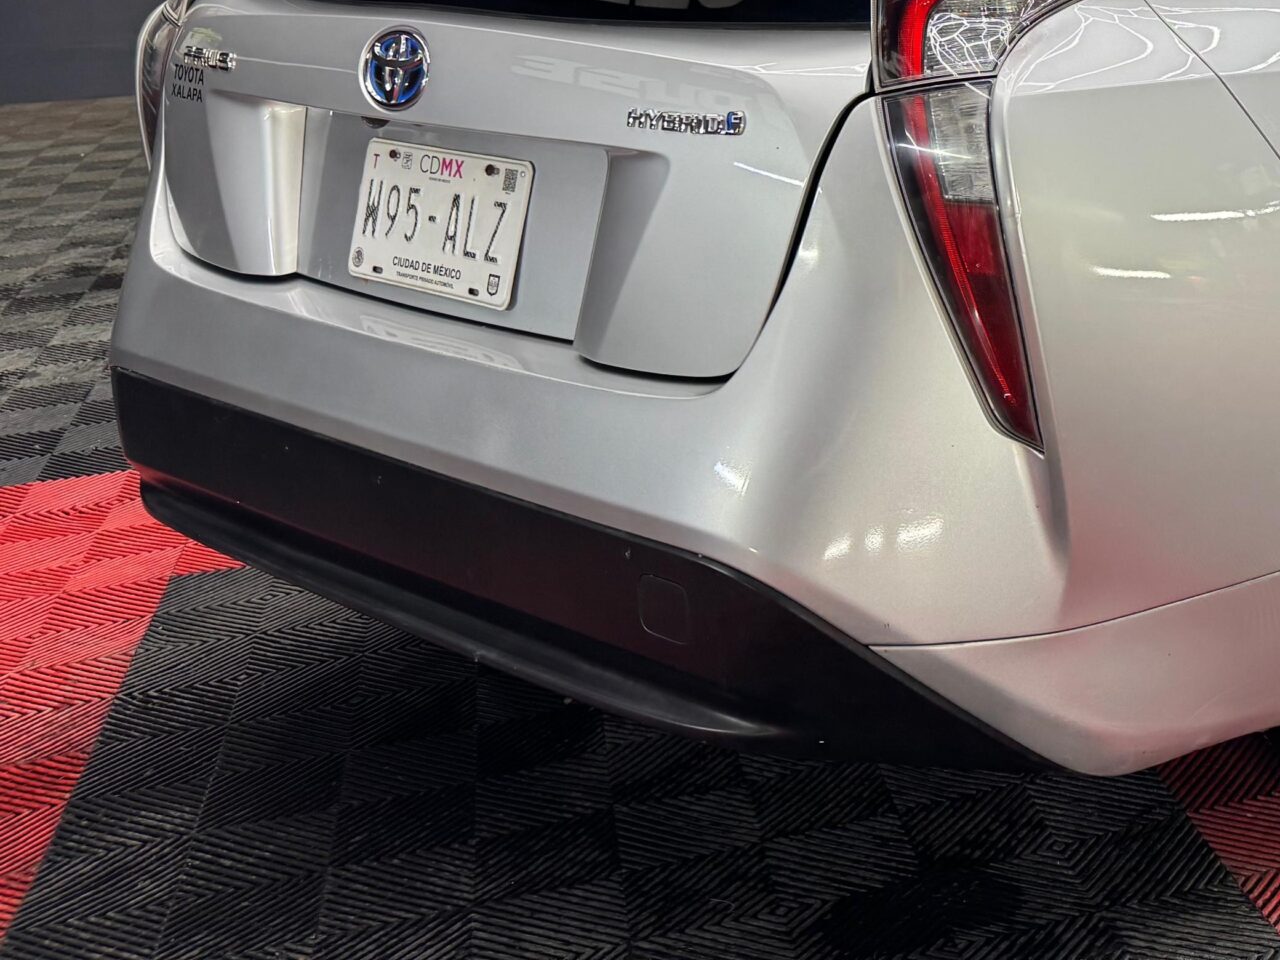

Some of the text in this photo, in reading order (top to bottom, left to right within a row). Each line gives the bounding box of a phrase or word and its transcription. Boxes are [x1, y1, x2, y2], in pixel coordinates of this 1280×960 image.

[174, 63, 204, 86] TOYOTA
[171, 83, 203, 103] XALAPA
[626, 107, 725, 135] HYBRID
[373, 153, 381, 169] T
[419, 154, 465, 179] CDMX
[392, 256, 462, 280] CIUDAD DE MÉXICO
